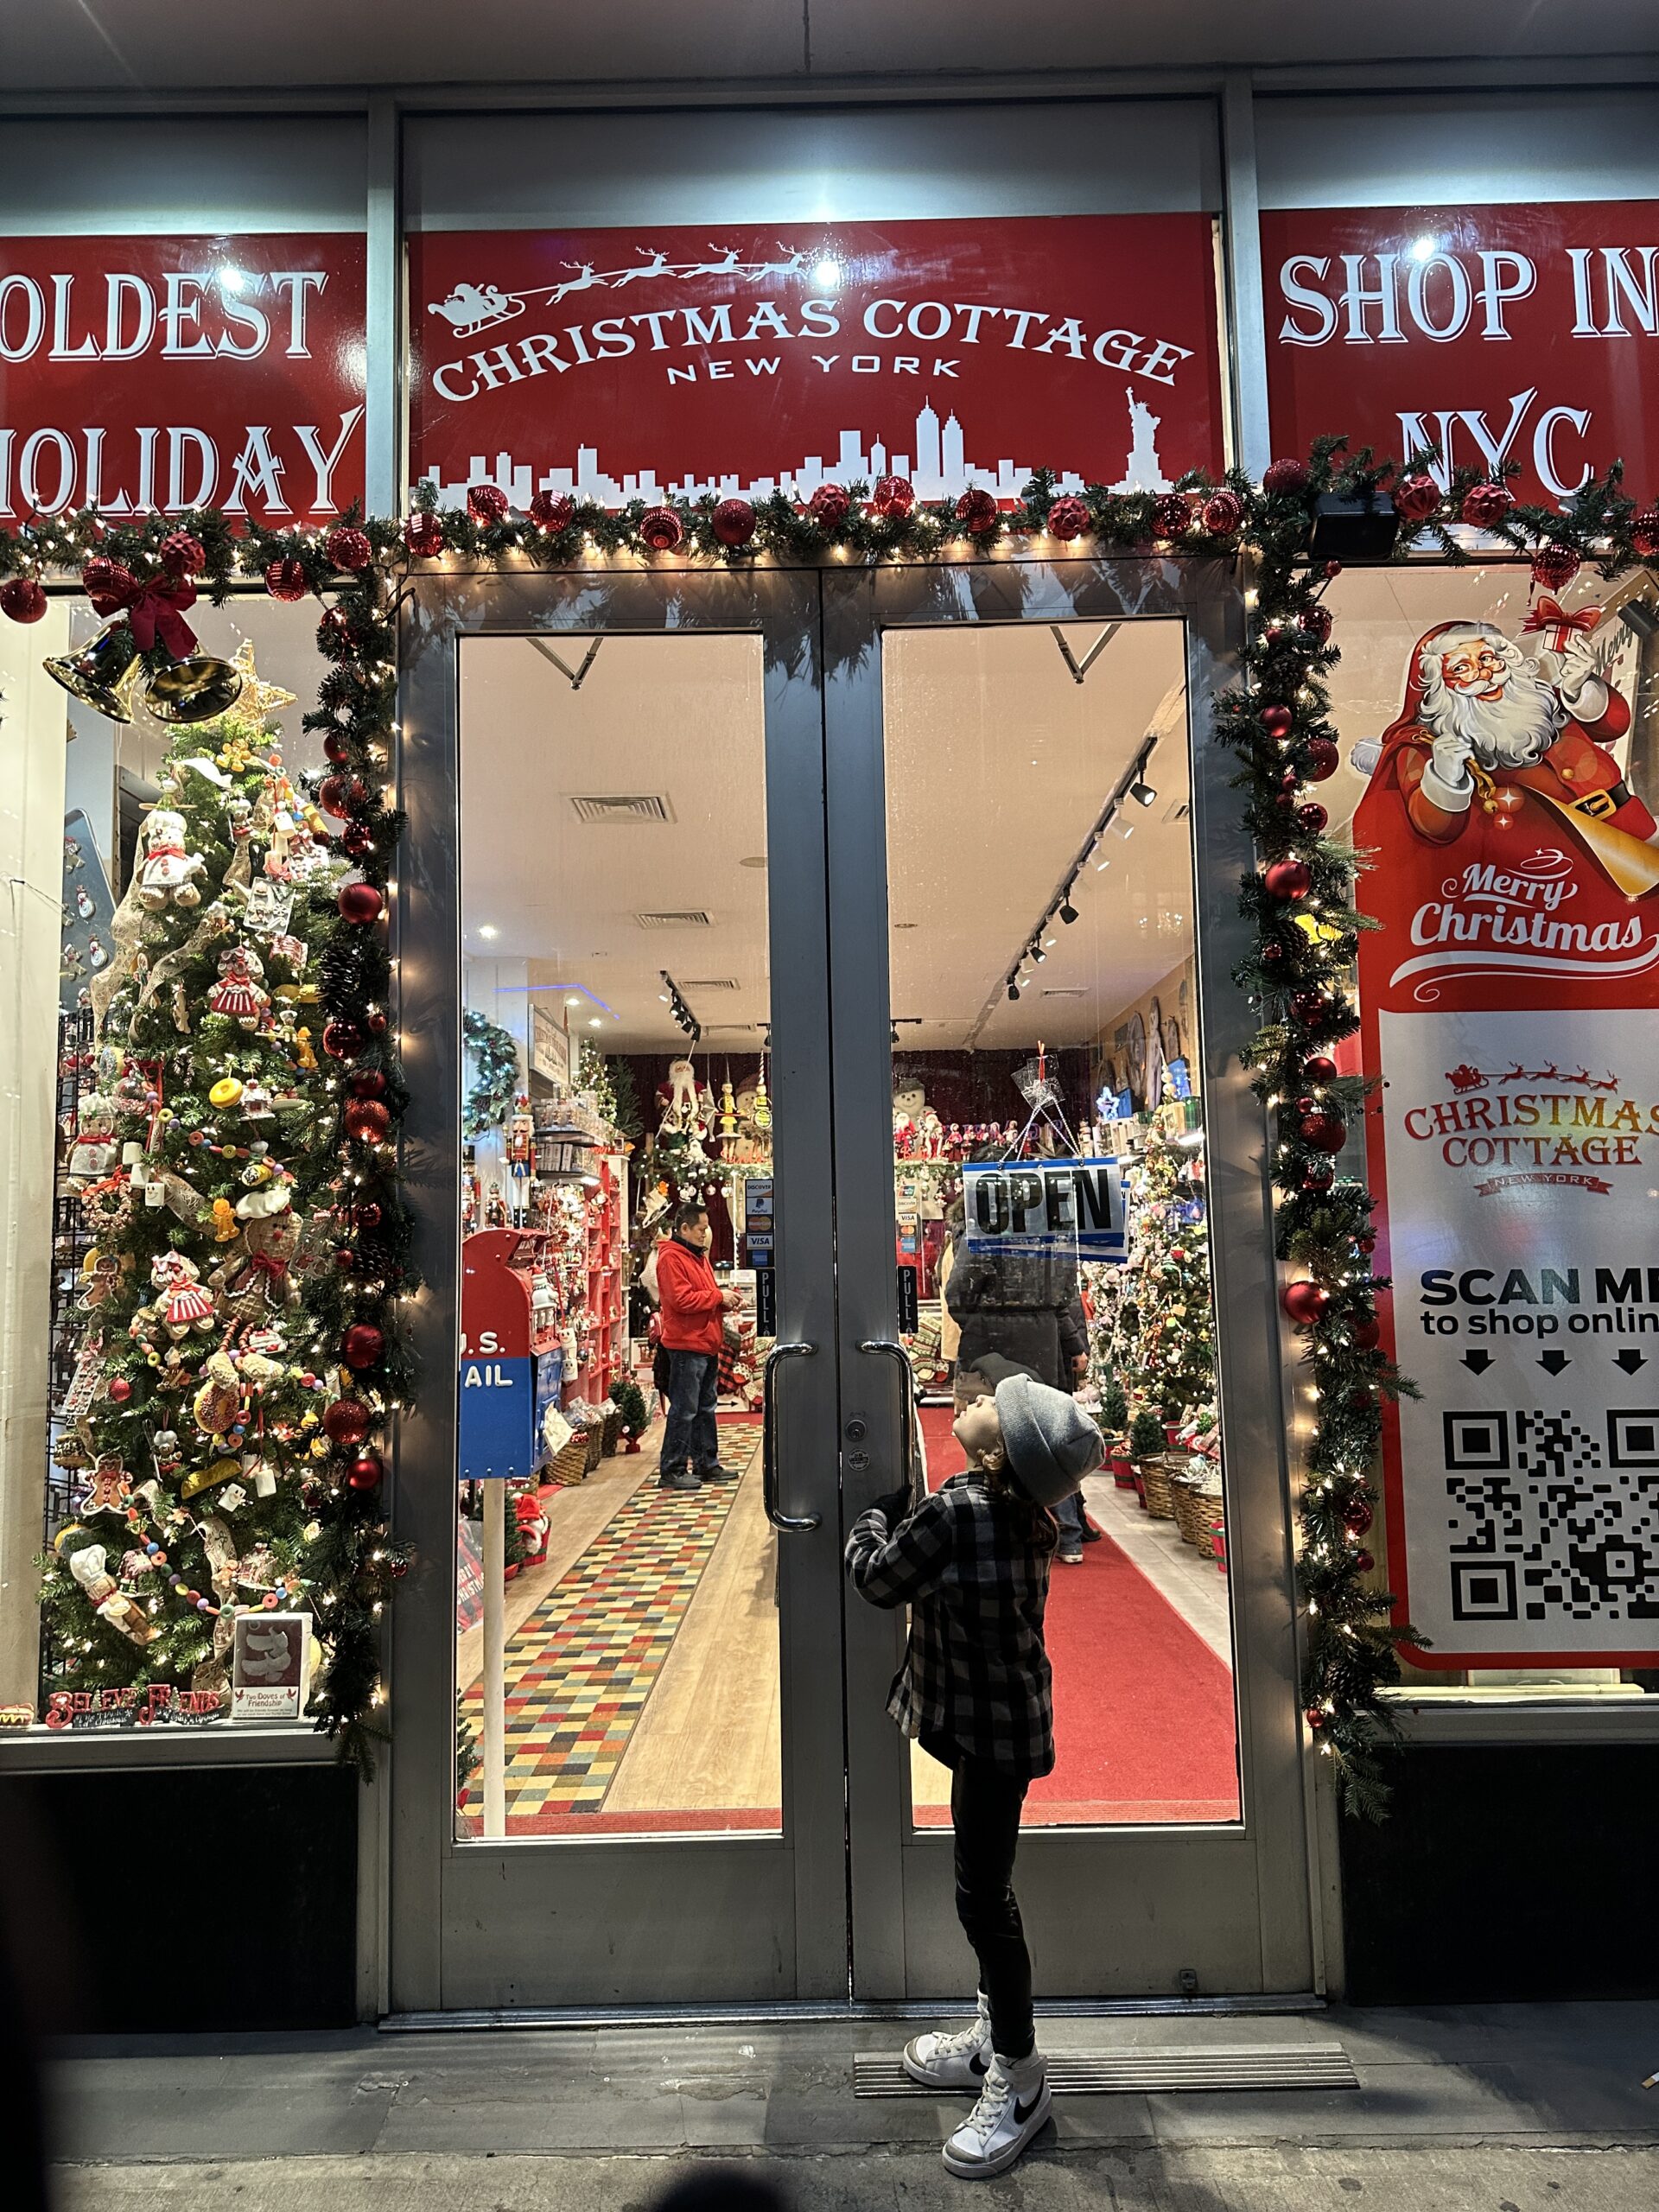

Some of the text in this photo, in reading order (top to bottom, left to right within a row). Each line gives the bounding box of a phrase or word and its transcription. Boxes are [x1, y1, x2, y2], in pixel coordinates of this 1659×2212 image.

[0, 271, 329, 363] OLDEST
[1279, 246, 1659, 346] SHOP IN
[432, 299, 1195, 402] CHRISTMAS COTTAGE
[666, 354, 961, 385] NEW YORK
[0, 404, 365, 518] OLIDAY
[1395, 386, 1593, 501] NYC
[1461, 863, 1579, 911] Merry
[1410, 902, 1642, 951] Christmas
[1442, 1135, 1642, 1167] COTTAGE
[976, 1169, 1112, 1235] OPEN
[1495, 1173, 1594, 1185] NEW YORK
[903, 1269, 912, 1320] PULL
[1420, 1268, 1580, 1306] SCAN
[1421, 1310, 1459, 1335] to
[1467, 1308, 1559, 1338] shop
